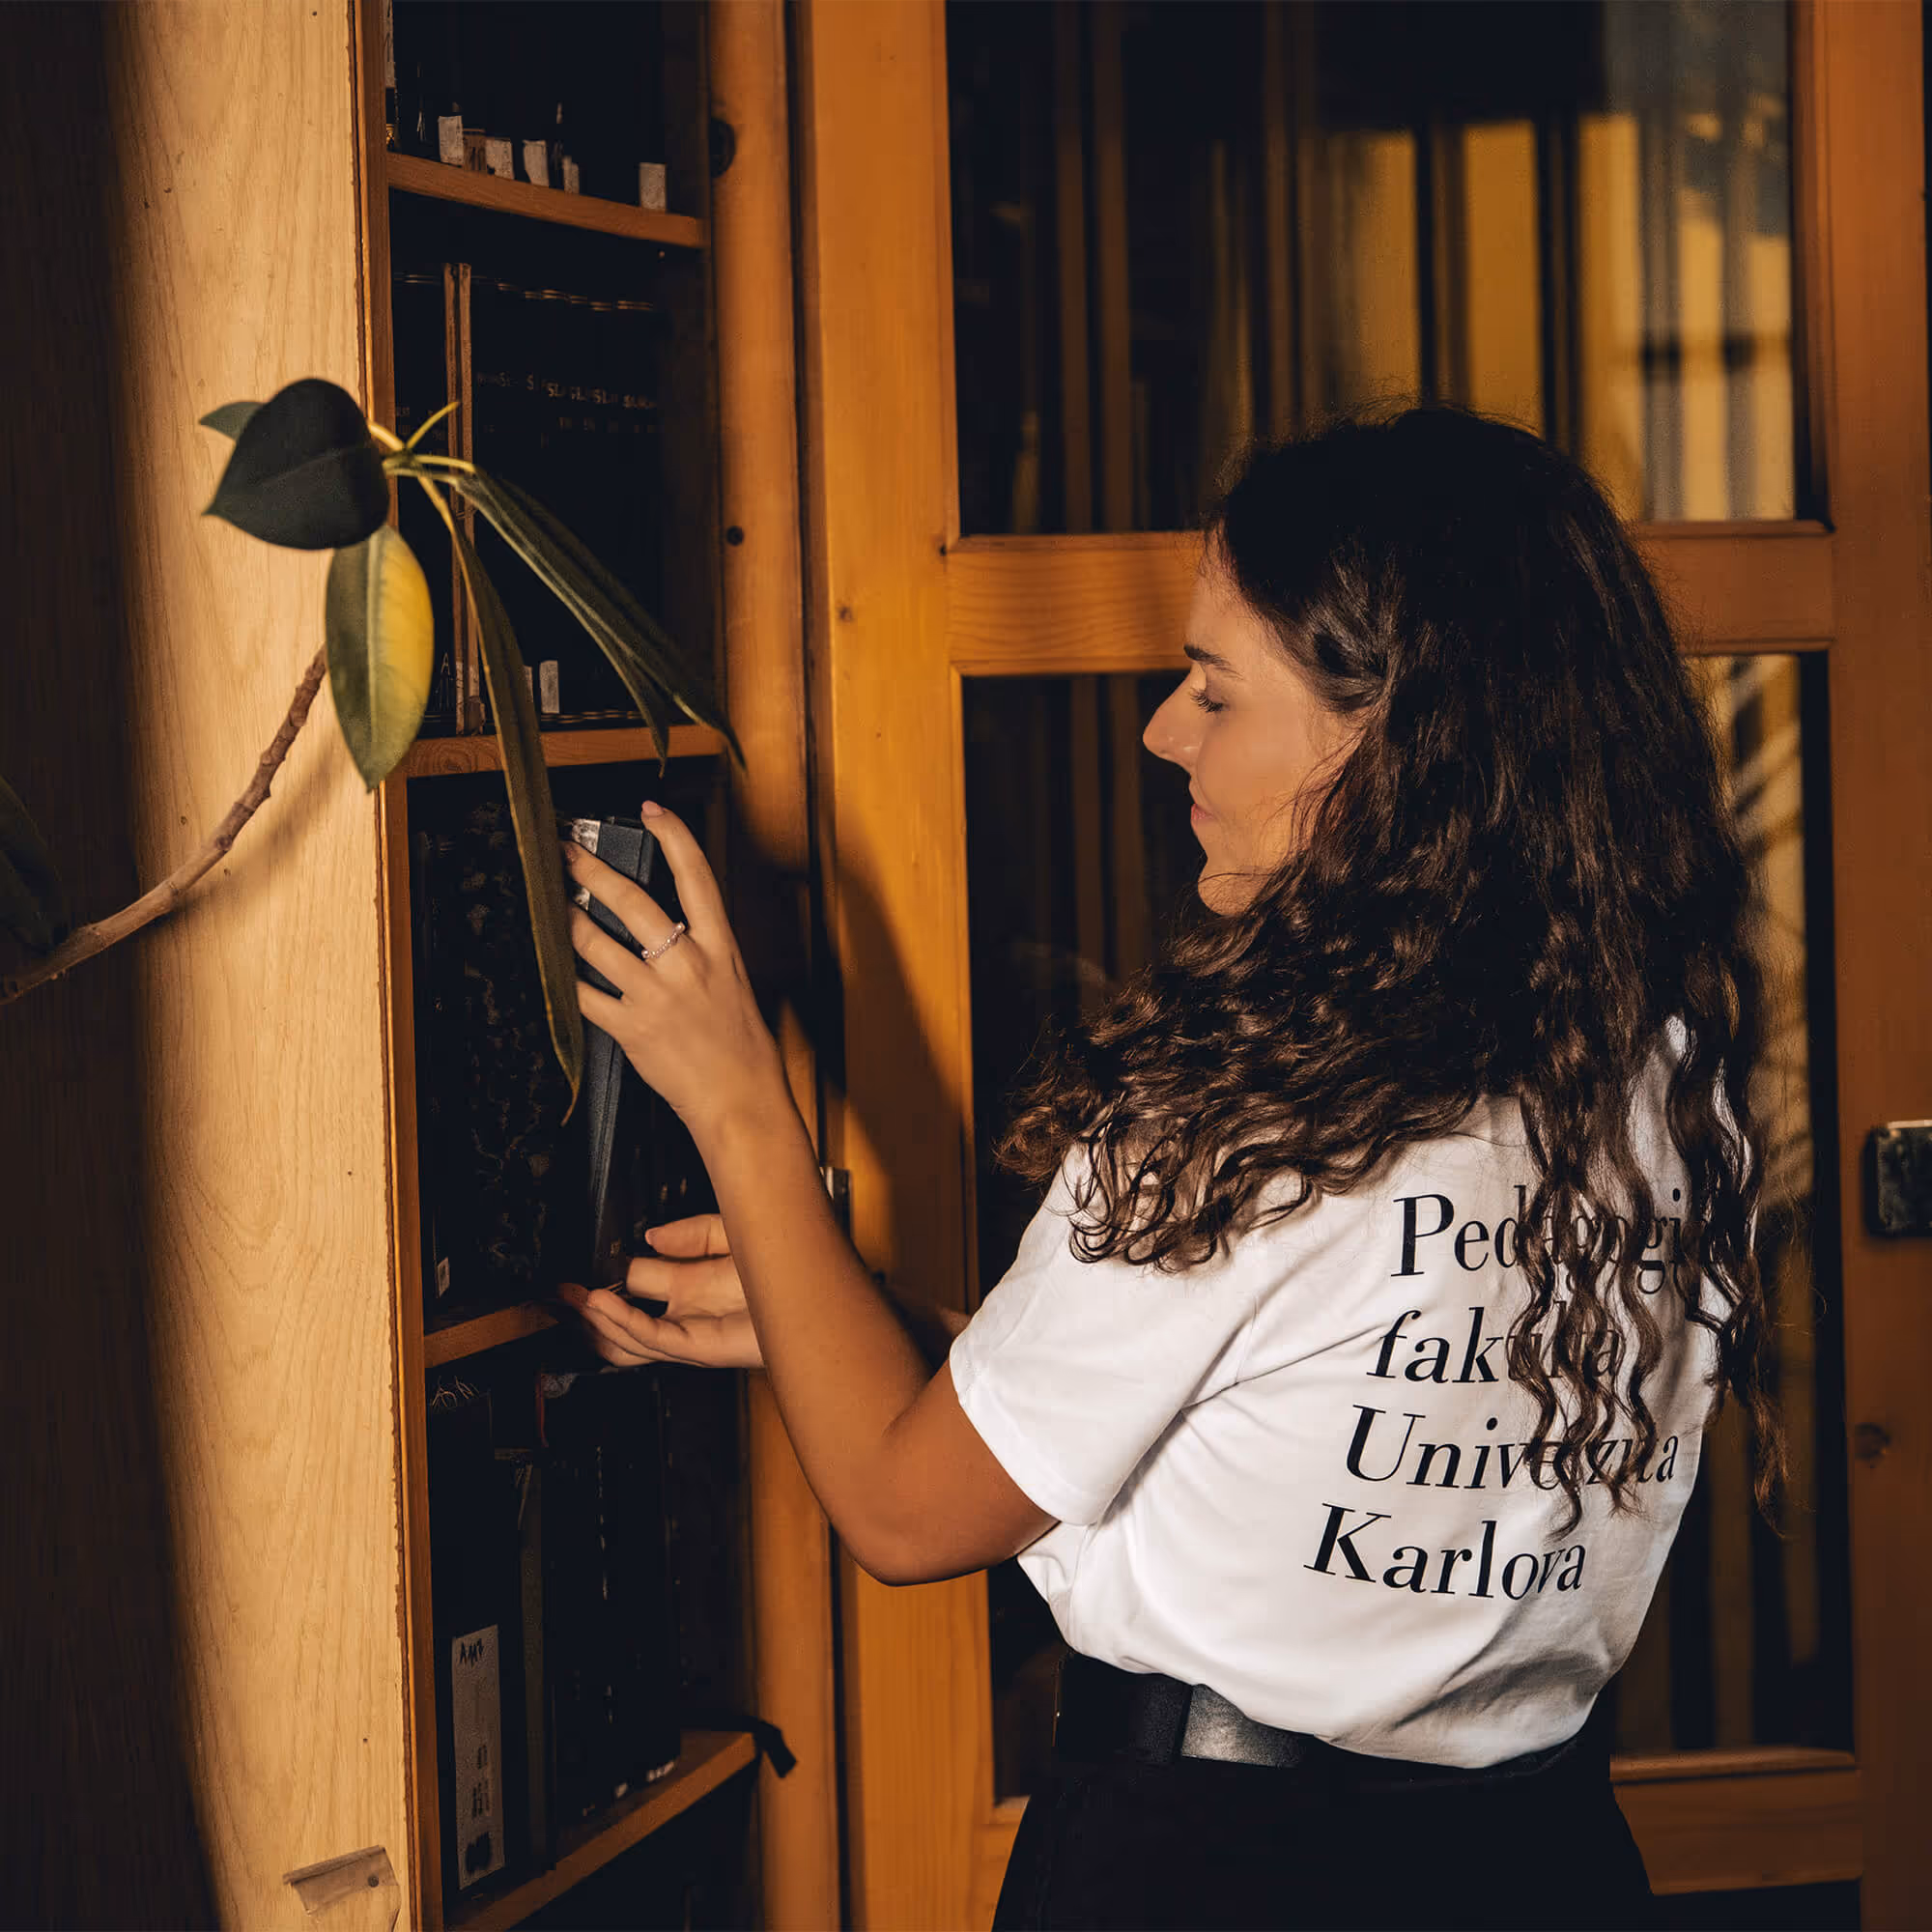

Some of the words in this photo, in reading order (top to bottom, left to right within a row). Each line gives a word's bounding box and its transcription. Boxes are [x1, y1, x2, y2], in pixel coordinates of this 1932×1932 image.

[1366, 1300, 1621, 1384] fakula
[1346, 1405, 1679, 1491] Univezia
[1303, 1503, 1586, 1600] Karlova
